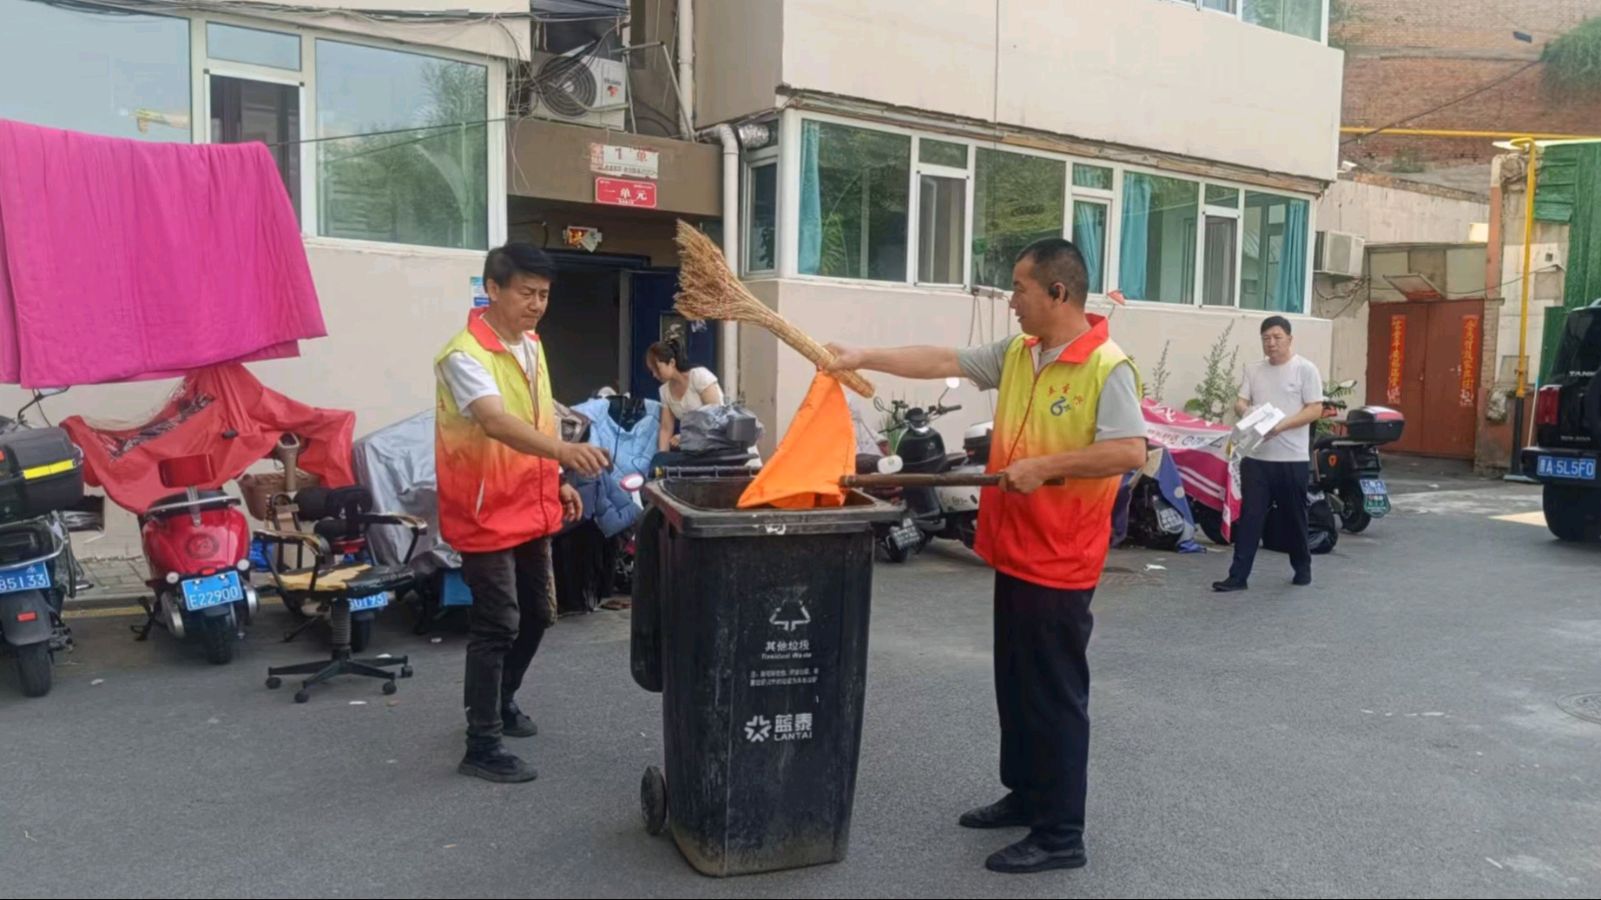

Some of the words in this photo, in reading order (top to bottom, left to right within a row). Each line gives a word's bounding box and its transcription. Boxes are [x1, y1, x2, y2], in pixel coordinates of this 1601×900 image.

[189, 586, 239, 608] E22900
[775, 712, 813, 733] 蓝泰
[774, 731, 813, 741] LANTAI
